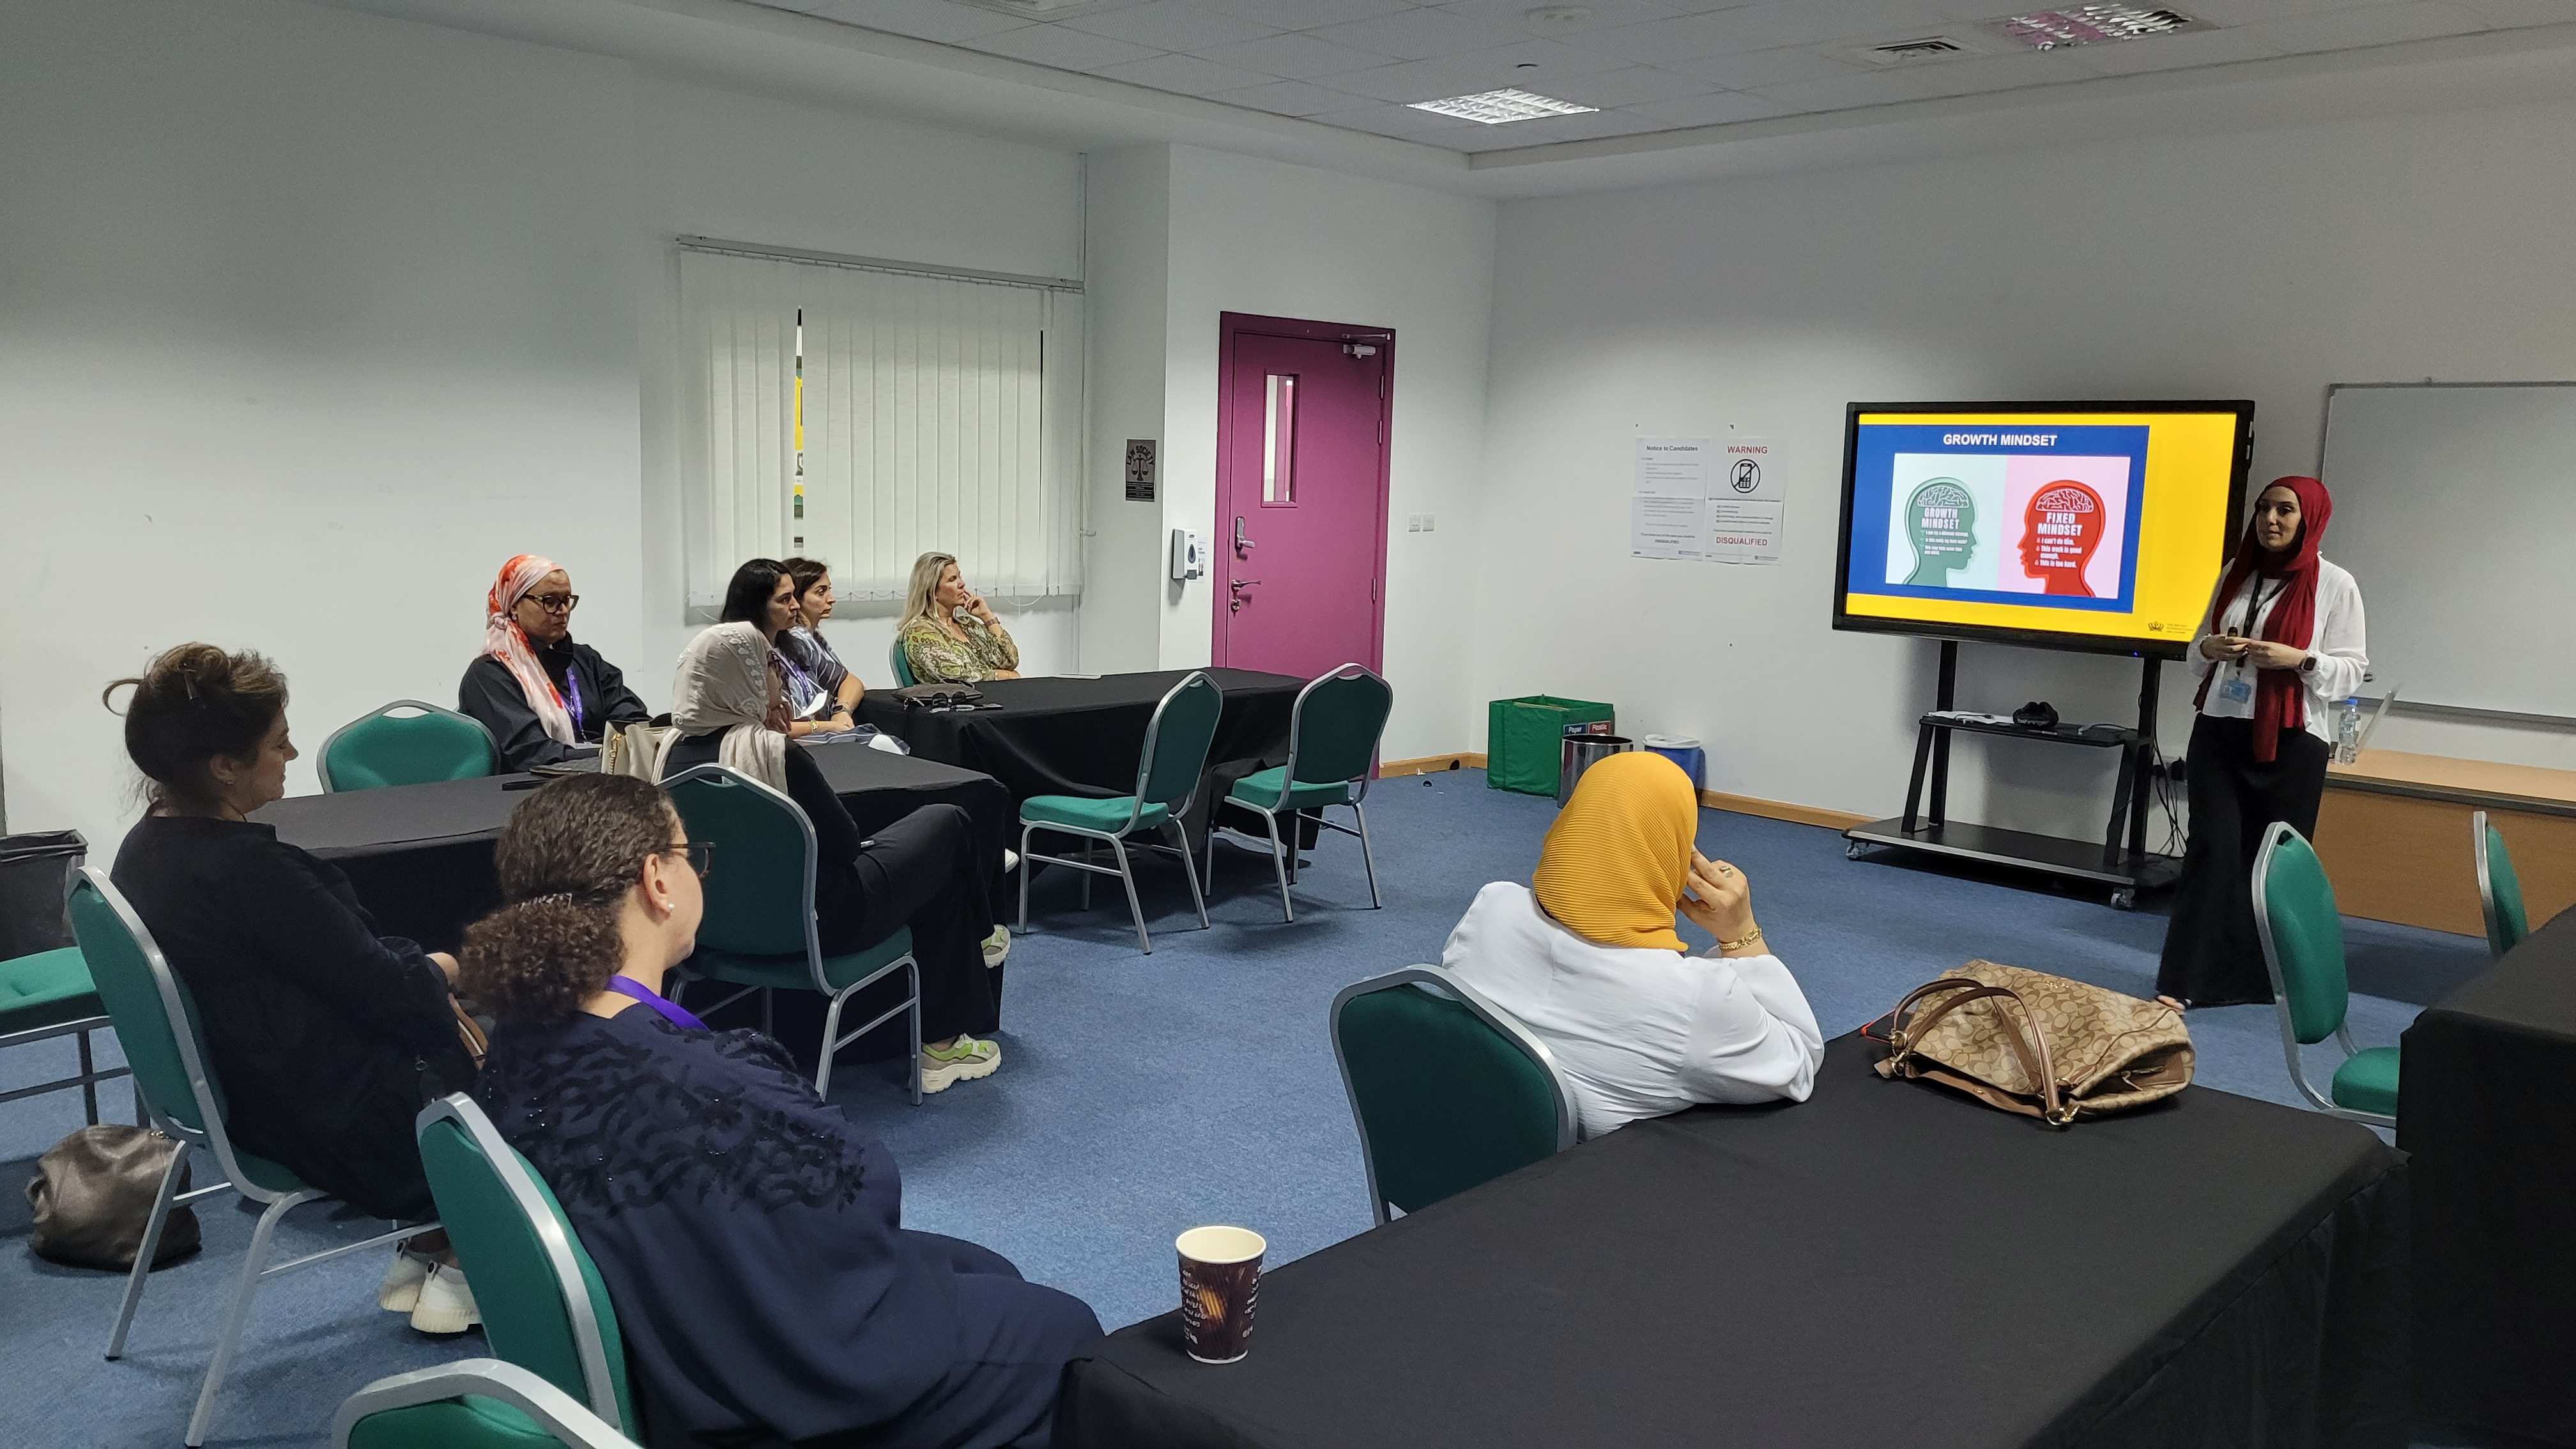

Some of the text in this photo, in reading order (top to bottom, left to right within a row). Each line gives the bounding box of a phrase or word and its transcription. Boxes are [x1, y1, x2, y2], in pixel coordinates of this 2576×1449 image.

[1943, 434, 2057, 446] GROWTH MINDSET
[1126, 445, 1155, 465] LAW SOCIETY
[1727, 446, 1768, 454] WARNING
[1924, 507, 1958, 518] GROWTH
[2046, 512, 2076, 524] FIXED
[1921, 518, 1959, 530] MINDSET
[2037, 523, 2083, 536] MINDSET
[1716, 537, 1768, 546] DISQUALIFIED
